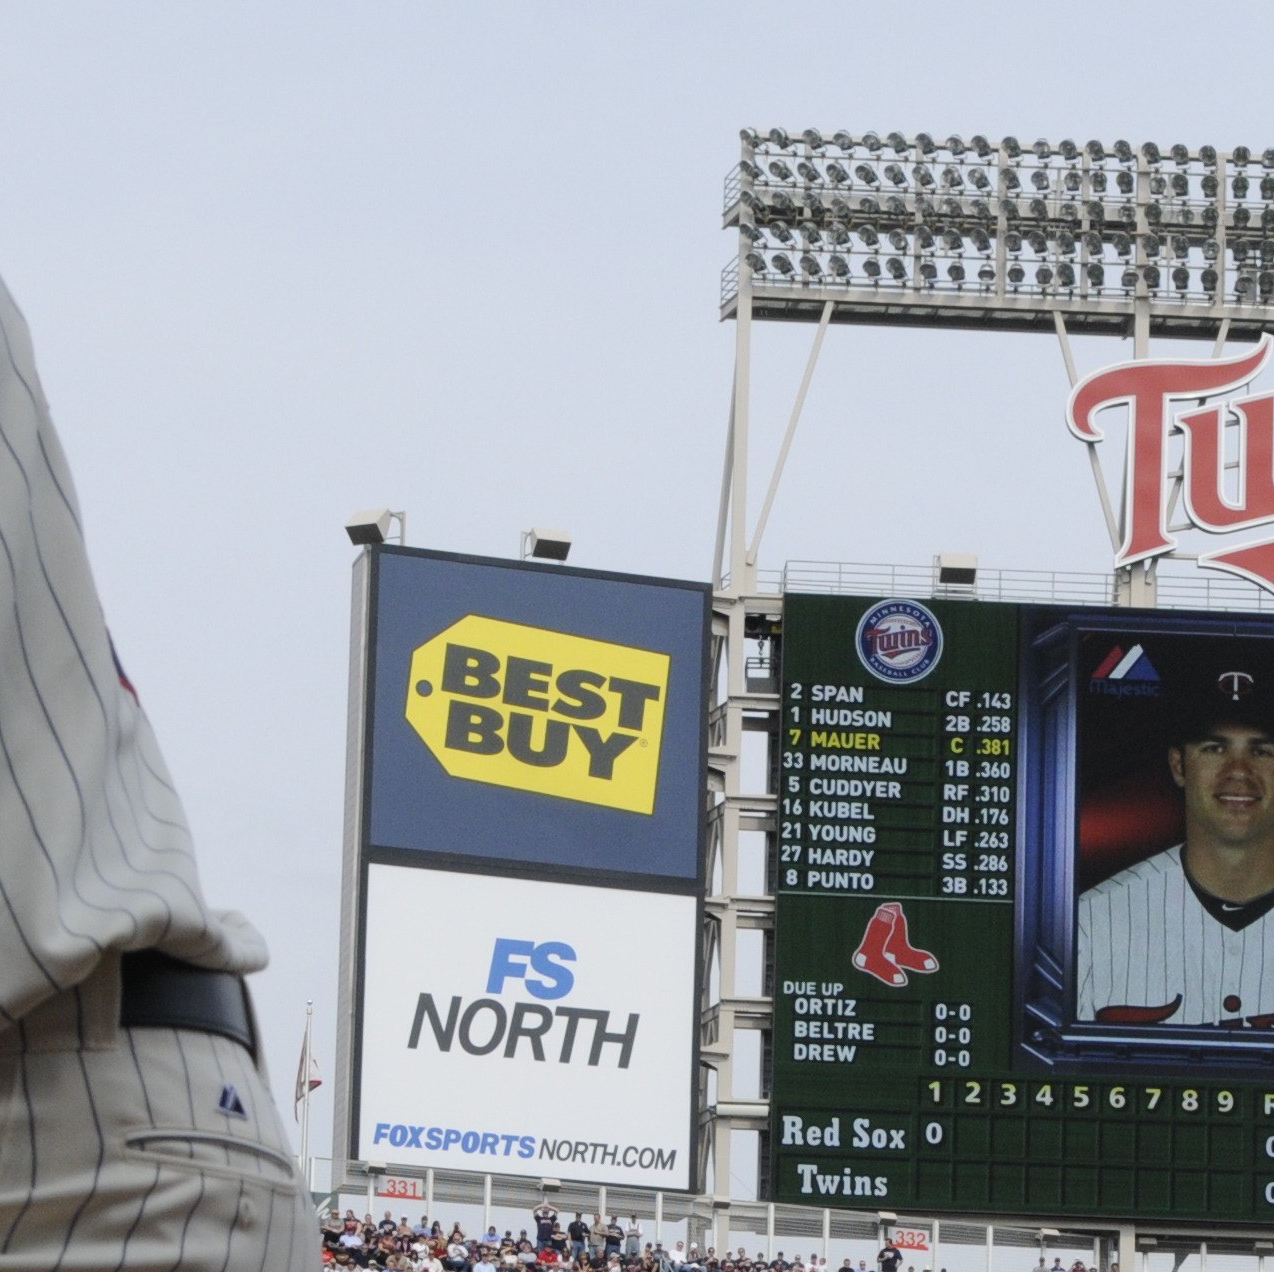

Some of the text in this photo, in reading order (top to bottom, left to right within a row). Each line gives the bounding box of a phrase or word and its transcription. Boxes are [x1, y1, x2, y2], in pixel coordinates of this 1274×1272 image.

[870, 605, 930, 627] MINNESOTA
[866, 625, 932, 656] Twins
[871, 658, 929, 677] BASEBALL CLUB
[442, 643, 660, 735] BEST
[812, 685, 1010, 709] SPAN CF .143
[812, 708, 1010, 732] HUDSON 2B .258
[445, 697, 642, 780] BUY
[811, 731, 1009, 755] MAUER .381
[783, 752, 1010, 778] 33 MORNEAU 1B .360
[810, 778, 1009, 802] CUDDYER RF .310
[783, 799, 1008, 825] 16 KUBEL DH .176
[782, 822, 1008, 848] 21 YOUNG LF .263
[781, 845, 1008, 871] 27 HARDY SS .286
[808, 871, 1007, 895] PUNTO 3B .133
[486, 938, 576, 1000] FS
[784, 981, 843, 996] DUE UP
[795, 998, 970, 1020] ORTIZ 0-0
[408, 993, 639, 1069] NORTH
[795, 1021, 970, 1044] BELTRE 0-0
[794, 1044, 970, 1066] DREW 0-0
[782, 1116, 905, 1149] Red Sox
[385, 1179, 419, 1196] 331
[798, 1164, 887, 1196] Twins
[895, 1231, 927, 1247] 332
